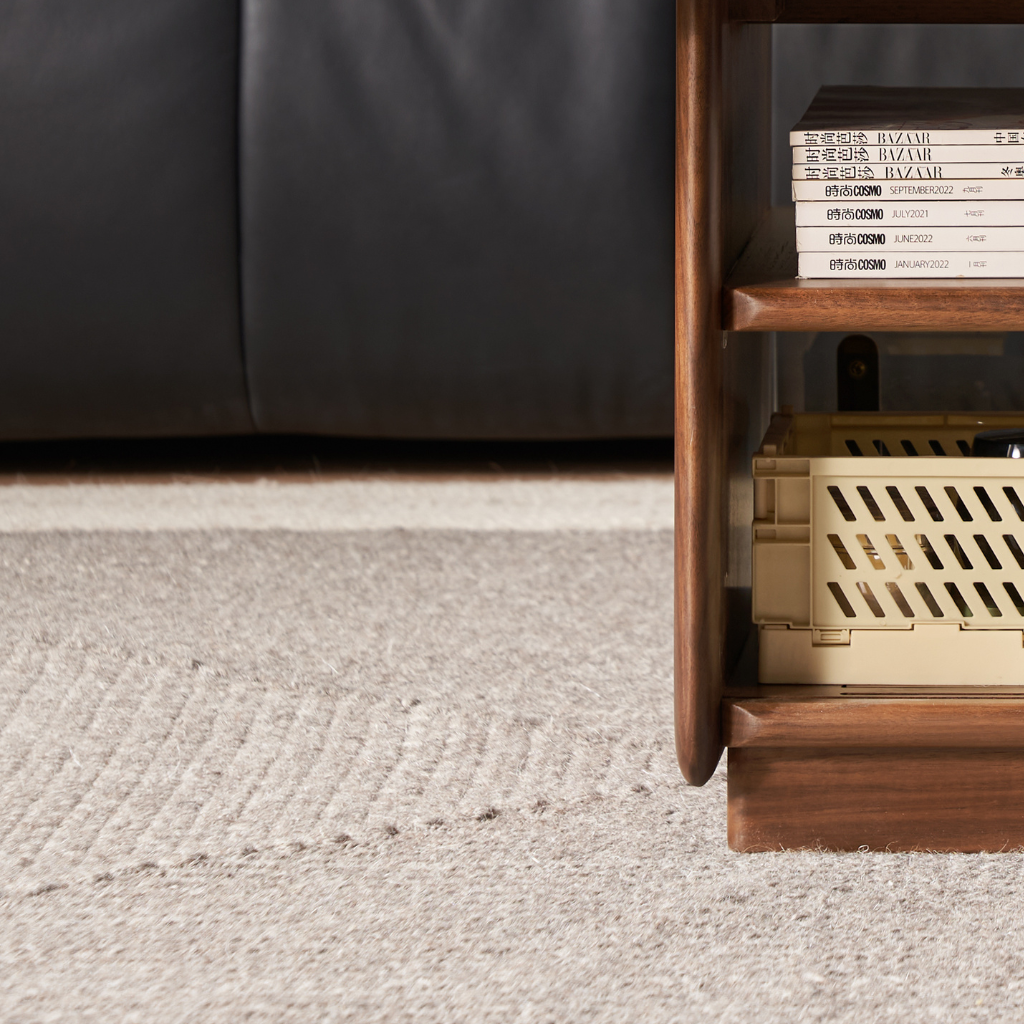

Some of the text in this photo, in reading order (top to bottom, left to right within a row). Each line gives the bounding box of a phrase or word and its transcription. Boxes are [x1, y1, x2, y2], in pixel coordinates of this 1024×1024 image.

[878, 133, 929, 144] BAZAAR
[880, 148, 931, 161] BAZAAR
[885, 166, 942, 179] BAZAAR
[890, 185, 954, 195] SEPTEMBER2022
[892, 209, 929, 219] JULY2021
[894, 234, 933, 243] JUNE2022
[894, 259, 950, 269] JANUARY2022
